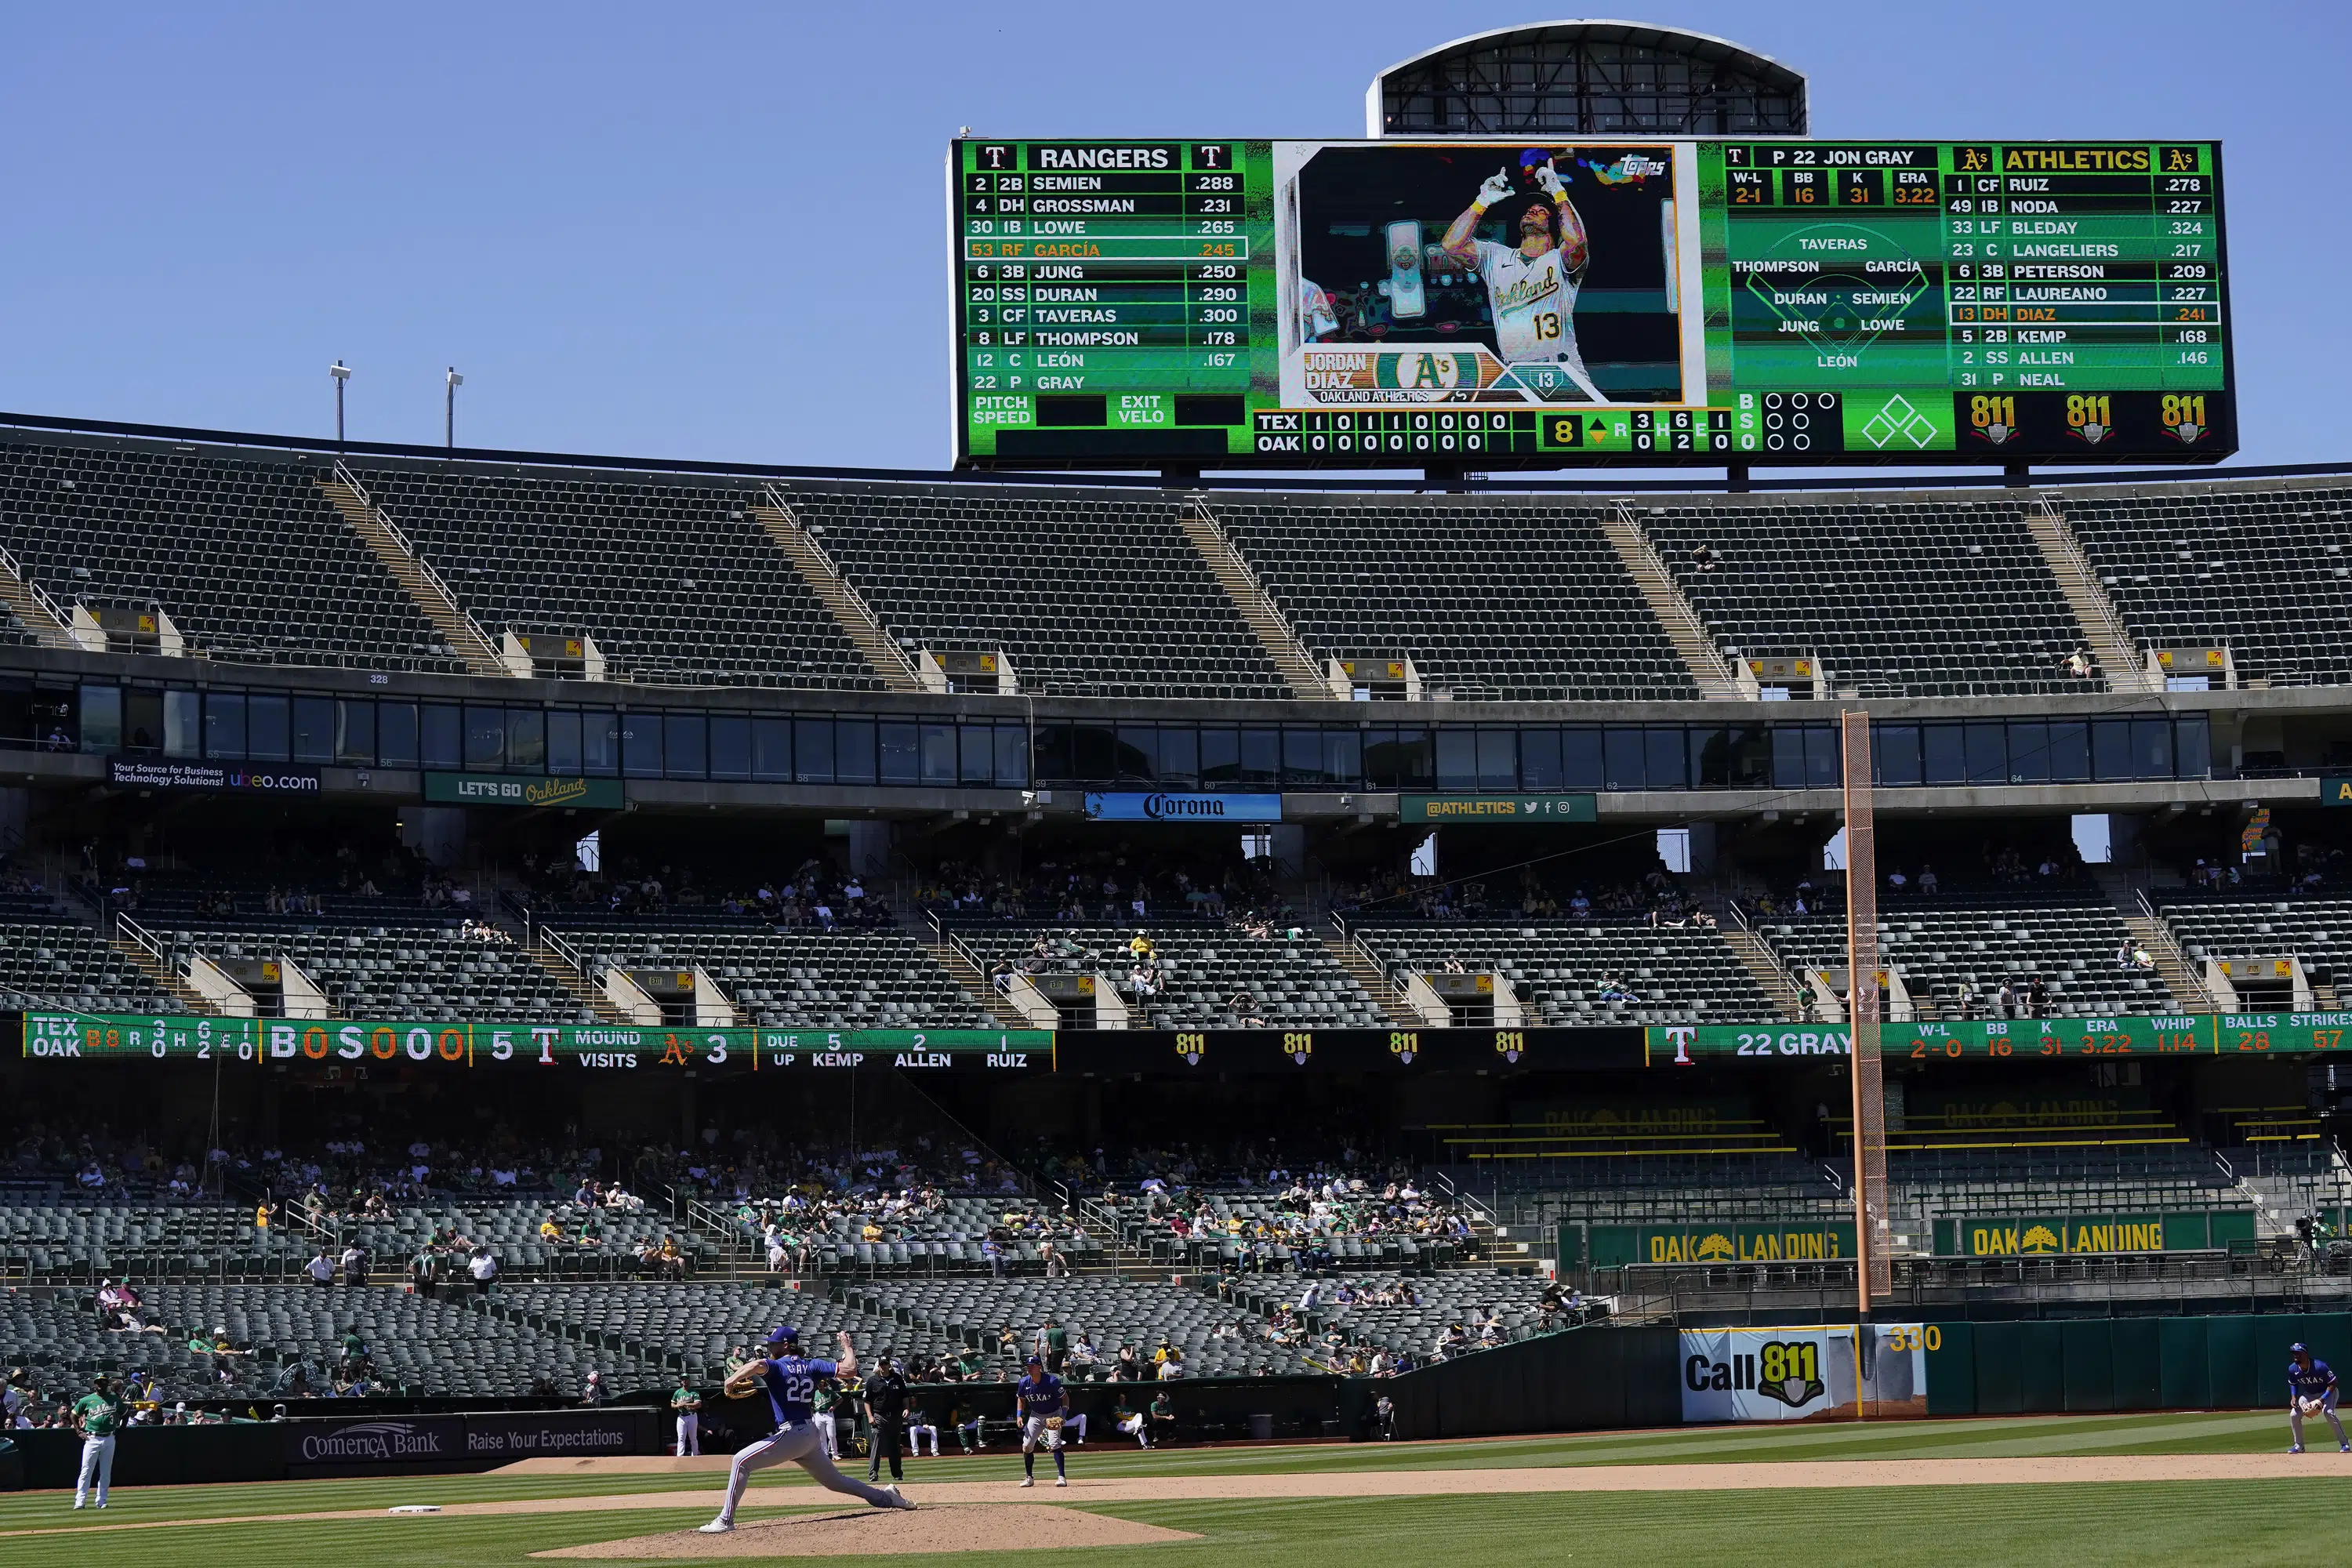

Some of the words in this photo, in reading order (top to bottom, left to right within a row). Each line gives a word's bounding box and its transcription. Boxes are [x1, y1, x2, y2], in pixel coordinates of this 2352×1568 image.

[1041, 149, 1167, 168] RANGERS
[1794, 151, 1815, 164] 22
[1824, 151, 1860, 164] JON
[1866, 151, 1914, 164] GRAY
[2006, 151, 2148, 169] ATHLETICS
[1033, 177, 1101, 190] SEMIEN
[1196, 177, 1232, 190] .288
[1733, 172, 1762, 183] W-L
[1795, 172, 1813, 183] BB
[1900, 173, 1927, 183] ERA
[2010, 179, 2049, 191] RUIZ
[2165, 179, 2200, 191] .278
[1736, 188, 1760, 202] 2-1
[1795, 188, 1814, 202] 16
[1850, 188, 1868, 202] 31
[1896, 188, 1934, 202] 3.22
[1033, 200, 1134, 212] GROSSMAN
[1200, 199, 1230, 212] .231
[1951, 200, 1971, 212] 49
[2012, 201, 2059, 212] NODA
[2167, 201, 2201, 212] .227
[971, 220, 993, 233] 30
[1034, 221, 1085, 234] LOWE
[1198, 221, 1234, 234] .265
[1953, 221, 1972, 233] 33
[2013, 222, 2077, 234] BLEDAY
[2169, 222, 2202, 234] .324
[972, 244, 993, 256] 53
[1035, 241, 1100, 256] GARCÍA
[1199, 244, 1234, 256] .245
[1799, 239, 1867, 249] TAVERAS
[1953, 244, 1973, 256] 23
[2013, 245, 2118, 256] LANGELIERS
[2172, 245, 2201, 256] .217
[1035, 266, 1083, 278] JUNG
[1199, 265, 1236, 278] .250
[1733, 261, 1819, 272] THOMPSON
[1866, 259, 1922, 272] GARCÍA
[2015, 265, 2103, 278] PETERSON
[2170, 265, 2205, 278] .209
[972, 288, 994, 300] 20
[1036, 289, 1097, 301] DURAN
[1200, 288, 1236, 300] .290
[1775, 293, 1827, 304] DURAN
[1853, 293, 1911, 304] SEMIEN
[1955, 287, 1975, 299] 22
[2016, 288, 2107, 300] LAUREANO
[2172, 288, 2205, 299] .227
[1036, 310, 1116, 322] TAVERAS
[1200, 309, 1237, 321] .300
[1959, 308, 1974, 320] 13
[2017, 309, 2056, 321] DIAZ
[2176, 308, 2205, 320] .241
[1534, 314, 1561, 340] 13
[1778, 321, 1819, 332] JUNG
[1861, 320, 1904, 330] LOWE
[1036, 332, 1138, 345] THOMPSON
[1203, 332, 1235, 344] .178
[2018, 331, 2066, 343] KEMP
[2176, 330, 2206, 343] .168
[978, 354, 993, 366] 12
[1037, 351, 1083, 367] LEÓN
[1204, 354, 1235, 366] .167
[1306, 354, 1367, 370] JORDAN
[1818, 354, 1857, 367] LEÓN
[2019, 352, 2074, 364] ALLEN
[2177, 352, 2207, 364] .146
[975, 376, 996, 388] 22
[1038, 376, 1084, 389] GRAY
[1307, 372, 1353, 389] DIAZ
[1537, 372, 1554, 388] 13
[1962, 373, 1976, 385] 31
[2020, 374, 2065, 386] NEAL
[976, 397, 1027, 408] PITCH
[1320, 391, 1370, 402] OAKLAND
[974, 411, 1030, 423] SPEED
[1118, 410, 1163, 423] VELO
[1972, 395, 2014, 426] 811
[2067, 395, 2110, 426] 811
[2161, 395, 2205, 426] 811
[1259, 416, 1298, 429] TEX
[1258, 437, 1299, 451] OAK
[369, 675, 388, 684] 328
[114, 763, 135, 772] Your
[136, 764, 167, 774] Source
[185, 767, 223, 776] Business
[114, 773, 171, 786] Technology
[174, 776, 223, 786] Solutions!
[230, 768, 318, 789] ubeo.com
[459, 782, 498, 796] LET'S
[502, 783, 521, 797] GO
[525, 779, 586, 806] Oakland
[1142, 793, 1225, 818] Corona
[1427, 801, 1515, 817] @ATHLETICS
[34, 1017, 78, 1036] TEX
[2086, 1020, 2118, 1032] ERA
[2151, 1018, 2195, 1029] WHIP
[2226, 1015, 2277, 1028] BALLS
[2290, 1014, 2352, 1027] STRIKE
[1918, 1025, 1951, 1036] W-L
[1987, 1023, 2007, 1034] BB
[576, 1030, 641, 1044] MOUND
[768, 1036, 797, 1047] DUE
[1176, 1033, 1204, 1054] 811
[1390, 1032, 1417, 1053] 811
[2158, 1033, 2197, 1051] 1.14
[2239, 1032, 2270, 1050] 28
[2314, 1030, 2343, 1048] 57
[33, 1039, 81, 1056] OAK
[1737, 1034, 1772, 1055] 22
[1779, 1033, 1851, 1055] GRAY
[1990, 1038, 2012, 1056] 16
[2041, 1036, 2062, 1054] 31
[2082, 1035, 2132, 1054] 3.22
[579, 1053, 637, 1067] VISITS
[775, 1054, 794, 1065] UP
[813, 1053, 863, 1066] KEMP
[895, 1054, 951, 1066] ALLEN
[987, 1054, 1026, 1067] RUIZ
[1974, 1228, 2017, 1254] OAK
[2062, 1224, 2161, 1252] LANDING
[1651, 1236, 1698, 1262] OAK
[1739, 1233, 1838, 1261] LANDING
[1890, 1326, 1941, 1351] 330
[787, 1365, 808, 1374] GRAY
[1686, 1354, 1755, 1391] Call
[1764, 1345, 1815, 1381] 811
[787, 1377, 814, 1403] 22
[394, 1432, 440, 1453] Bank
[469, 1432, 503, 1450] Raise
[508, 1431, 536, 1448] Your
[541, 1430, 623, 1450] Expectations
